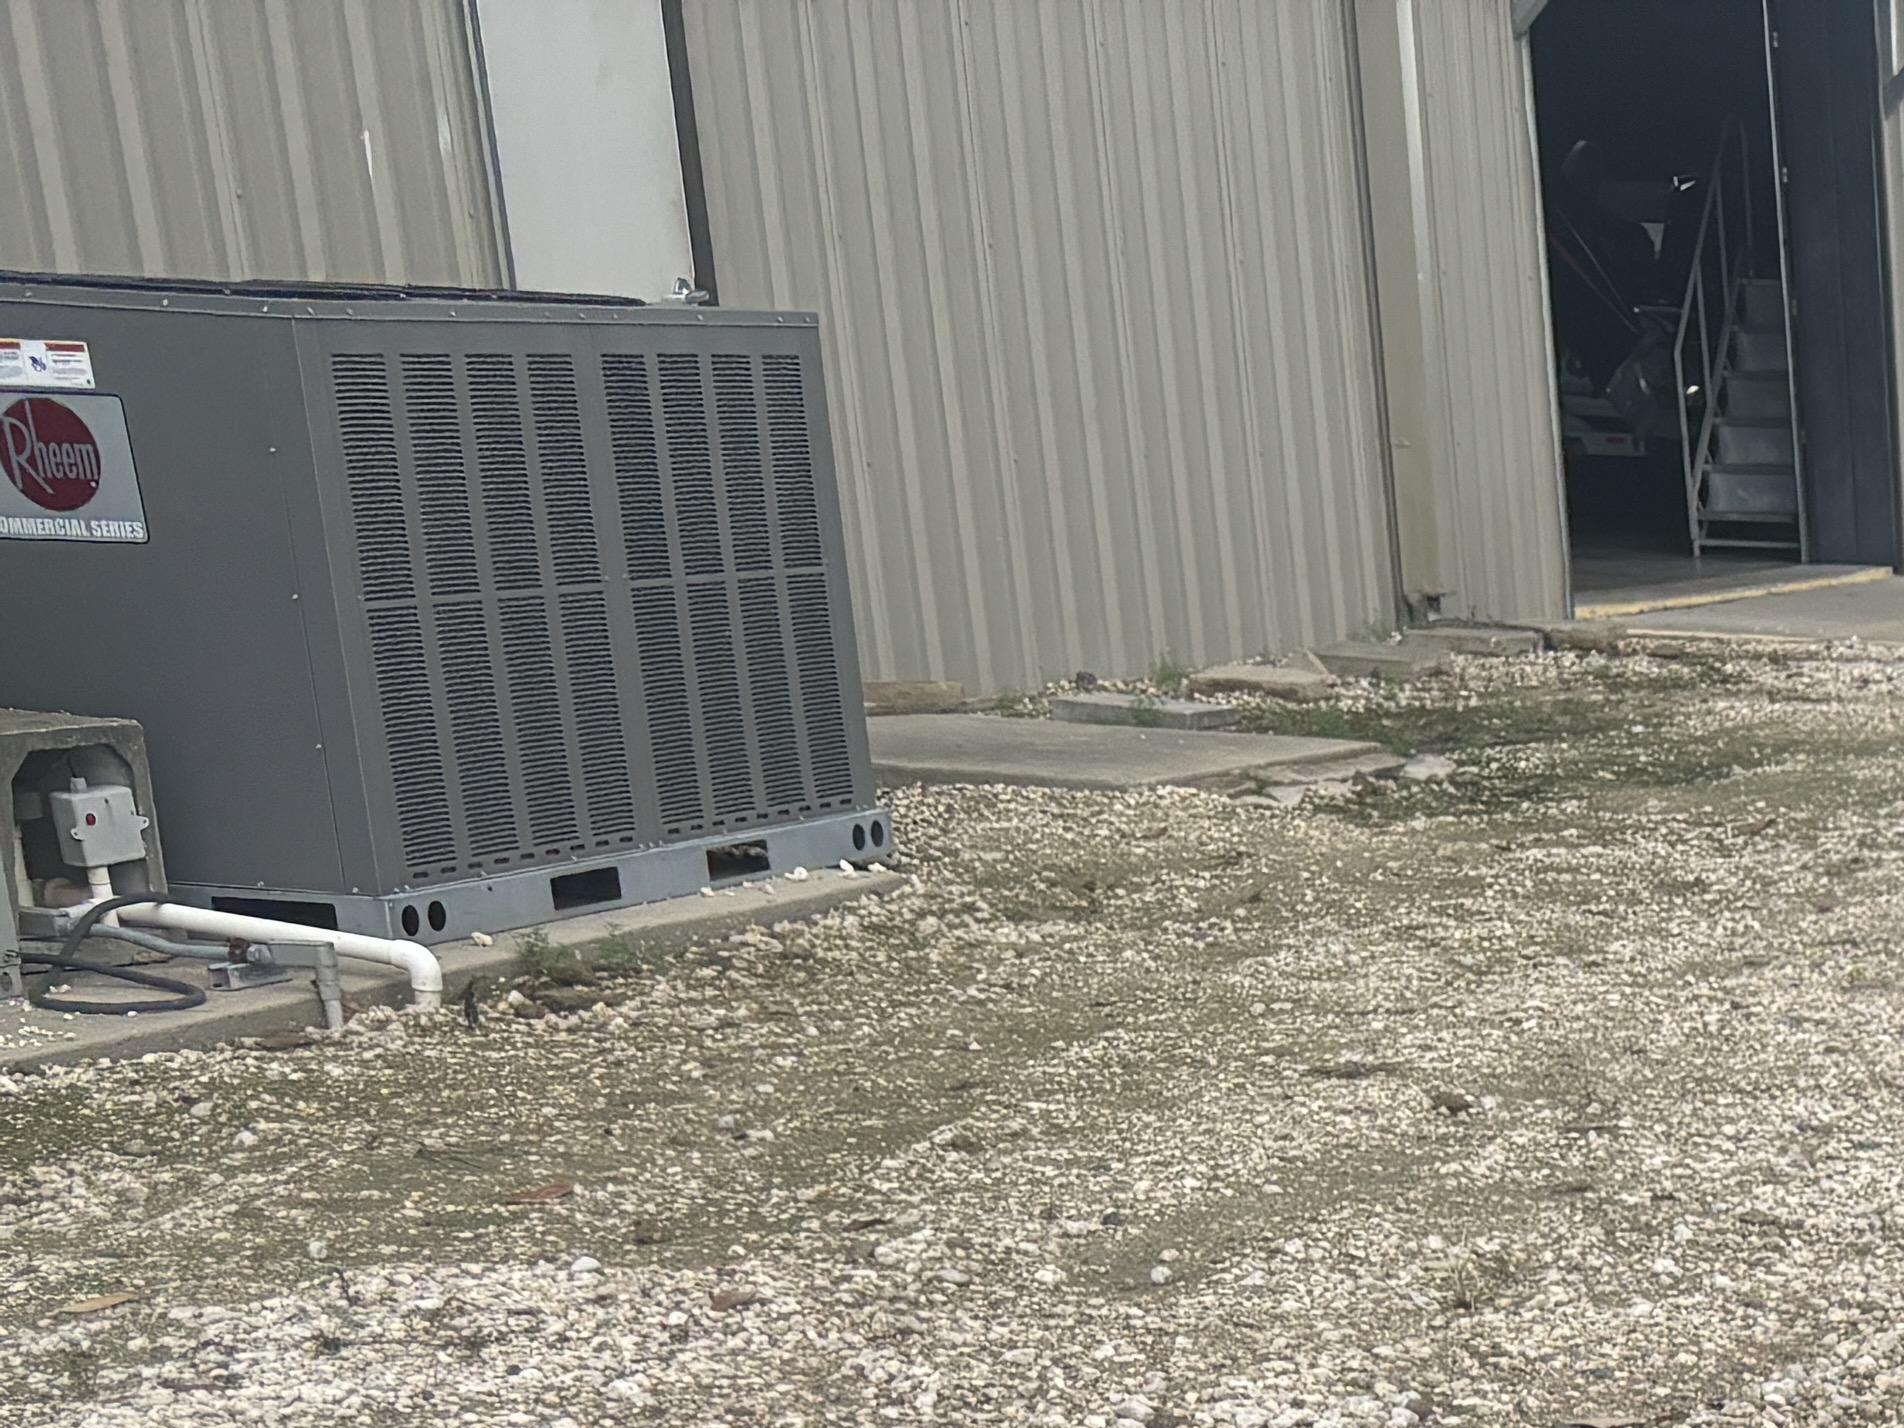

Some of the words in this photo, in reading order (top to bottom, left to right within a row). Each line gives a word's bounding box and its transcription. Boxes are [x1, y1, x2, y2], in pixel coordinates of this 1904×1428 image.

[0, 400, 98, 494] Rheem
[0, 516, 89, 536] OMMERCIAL
[91, 519, 144, 538] SERIES
